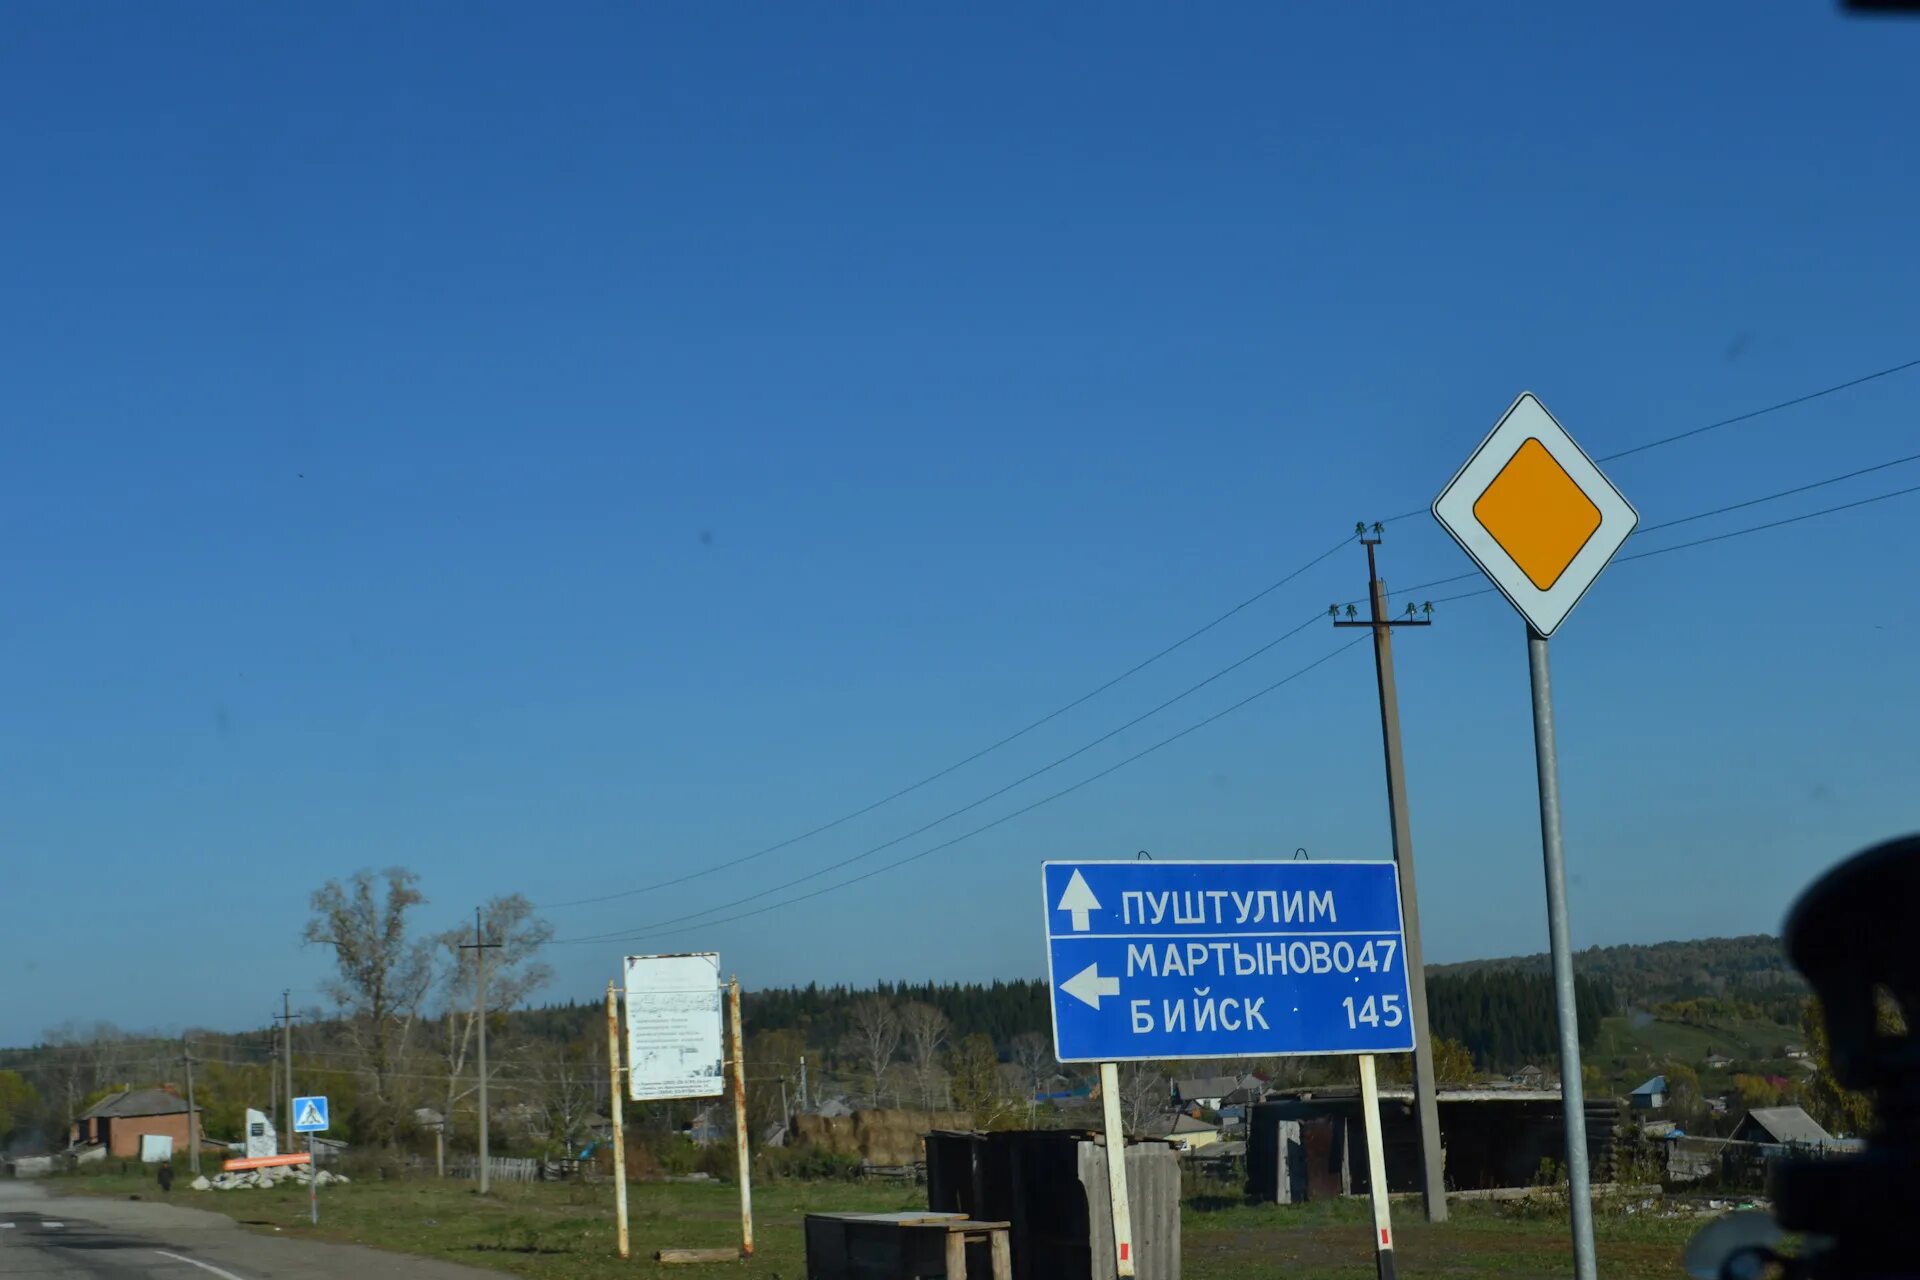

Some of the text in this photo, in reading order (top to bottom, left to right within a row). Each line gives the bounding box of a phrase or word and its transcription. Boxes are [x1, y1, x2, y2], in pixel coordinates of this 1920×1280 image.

[1123, 891, 1336, 924] ПУШТУЛИМ
[1131, 987, 1402, 1033] БИЙСК 145
